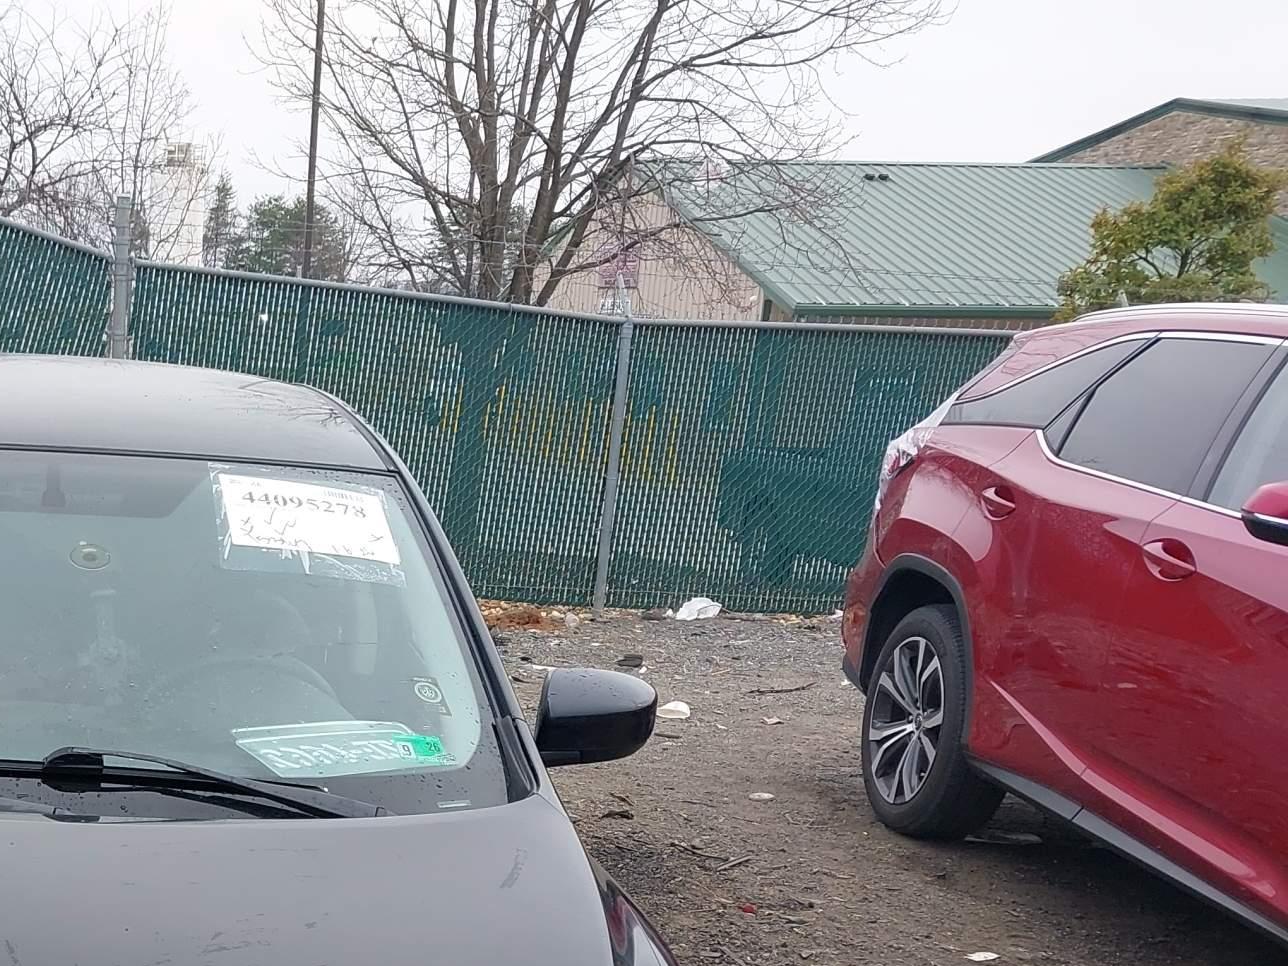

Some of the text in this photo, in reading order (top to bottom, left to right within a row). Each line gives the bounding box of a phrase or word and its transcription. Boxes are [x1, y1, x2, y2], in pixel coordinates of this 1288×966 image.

[241, 490, 367, 519] 44095278
[402, 744, 412, 757] 9
[426, 741, 441, 753] 26
